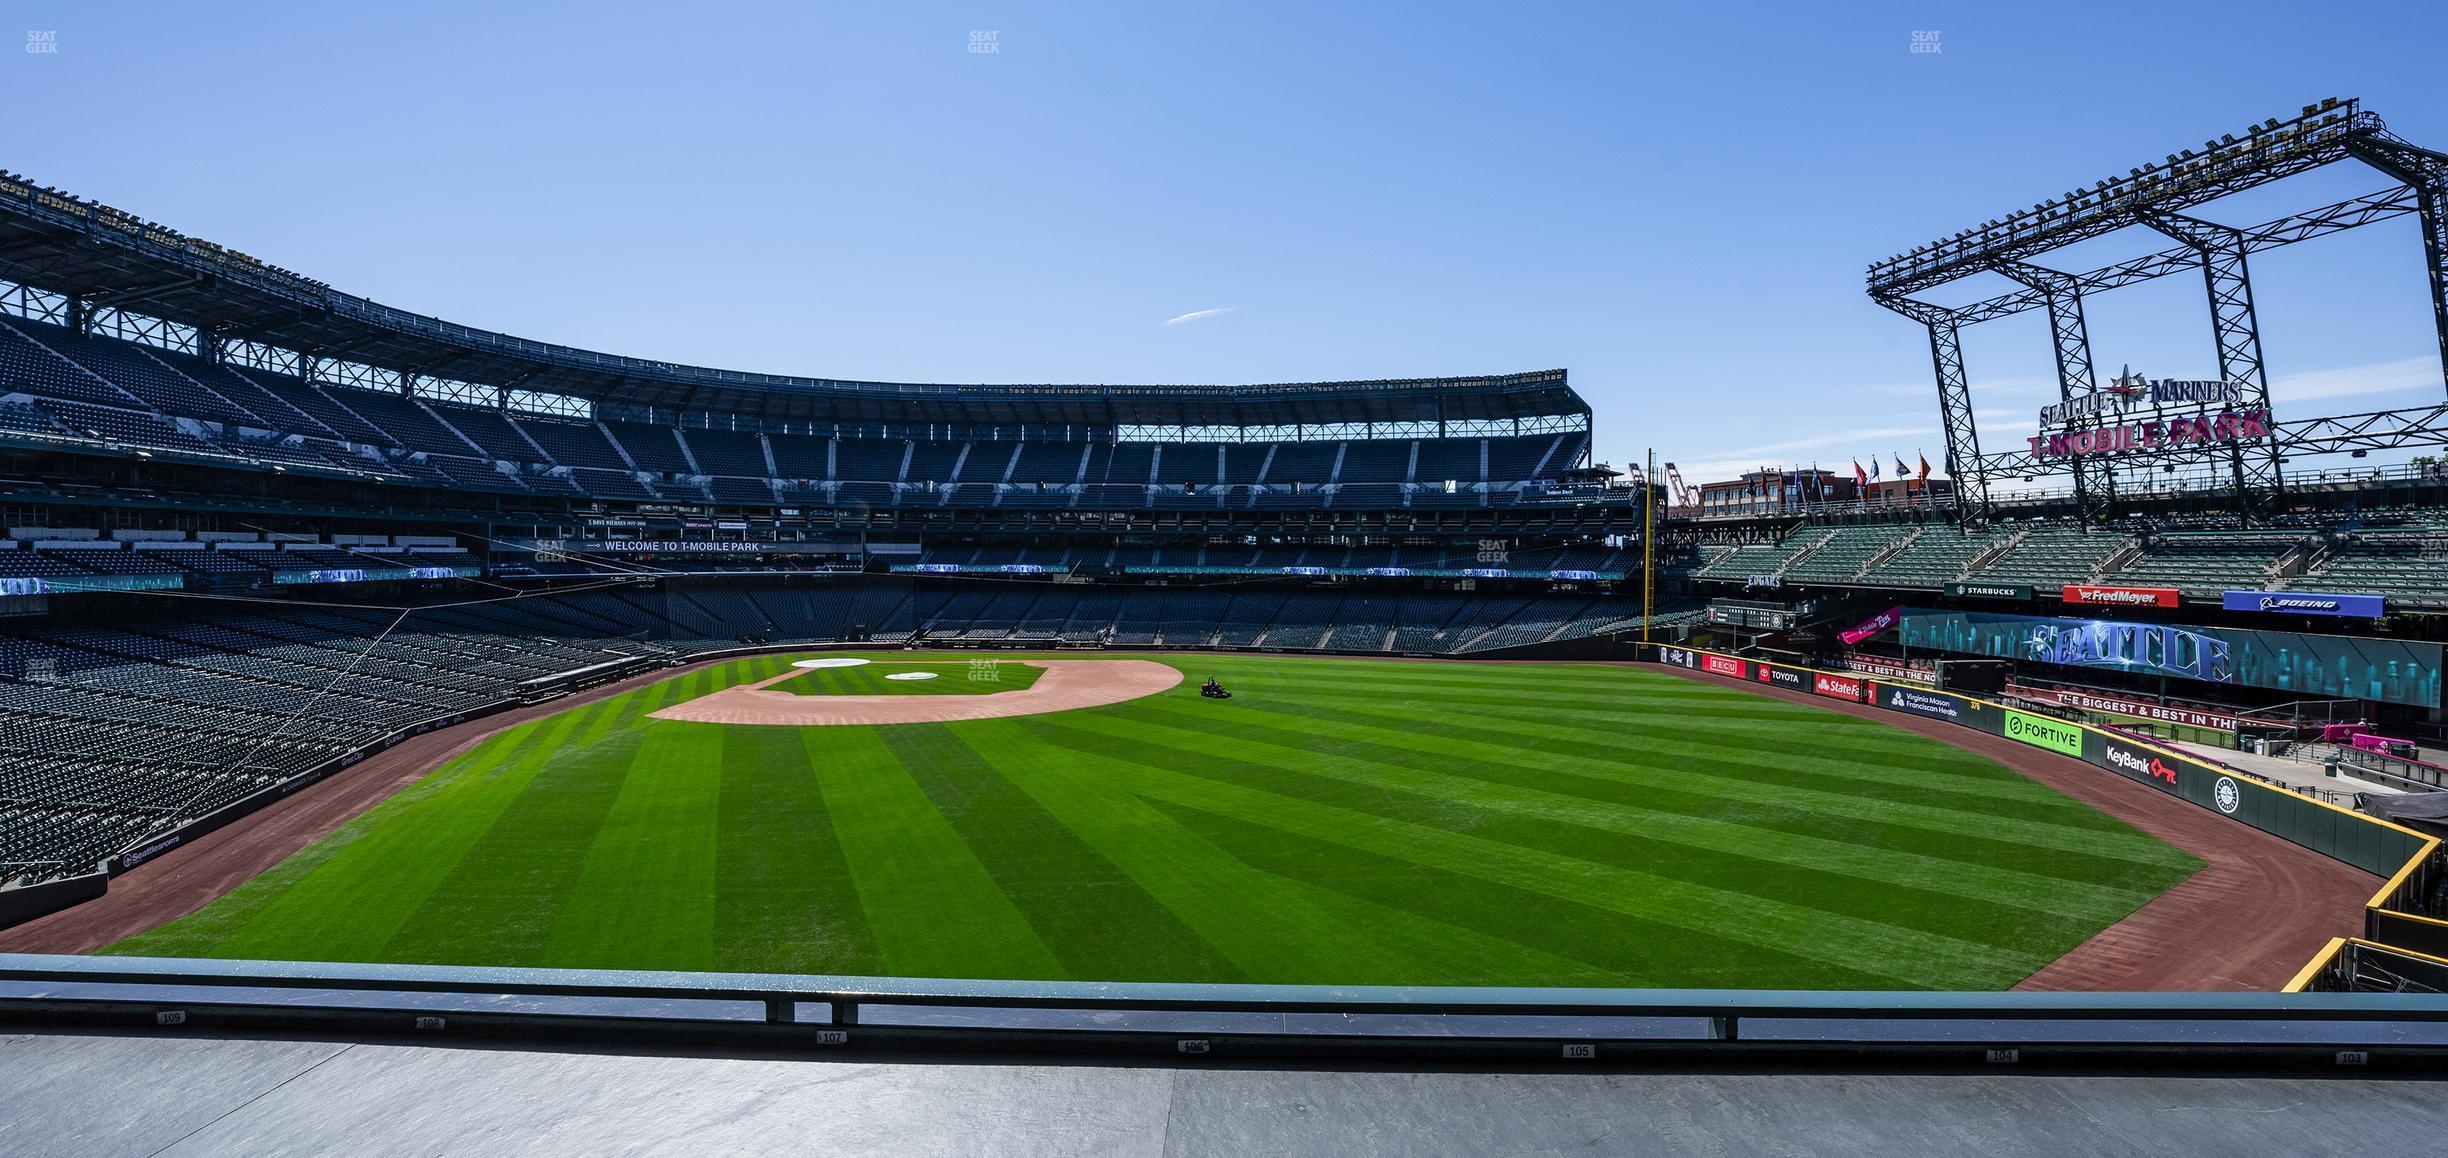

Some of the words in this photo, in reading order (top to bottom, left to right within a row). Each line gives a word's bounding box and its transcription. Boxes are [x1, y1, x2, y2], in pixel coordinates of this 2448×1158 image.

[2040, 392, 2110, 428] SEATTLE
[2150, 378, 2241, 404] MARINERS
[2027, 421, 2163, 459] T-MOBILE
[2170, 407, 2272, 445] PARK
[604, 541, 659, 551] WELCOME
[662, 541, 677, 551] TO
[681, 541, 729, 551] T-MOBILE
[731, 542, 759, 551] PARK
[1967, 587, 2015, 596] STARBUCKS
[2276, 599, 2337, 608] BOEING
[1711, 660, 1736, 671] BECU
[1771, 670, 1799, 683] TOYOTA
[1875, 666, 1894, 676] BEST
[1896, 669, 1904, 678] IN
[1906, 671, 1922, 680] THE
[1906, 693, 1929, 704] Virginia
[1929, 697, 1950, 707] Mason
[1906, 700, 1938, 712] Franciscan
[2057, 694, 2079, 705] THE
[2082, 697, 2135, 713] BIGGEST
[2139, 706, 2148, 716] &
[2152, 708, 2187, 722] BEST
[2192, 713, 2206, 725] IN
[2025, 724, 2077, 747] FORTIVE
[2106, 745, 2150, 775] KeyBank
[164, 1012, 181, 1023] 109
[823, 1032, 842, 1043] 107
[1569, 1046, 1589, 1057] 105
[1994, 1050, 2012, 1061] 104
[2342, 1053, 2361, 1063] 103
